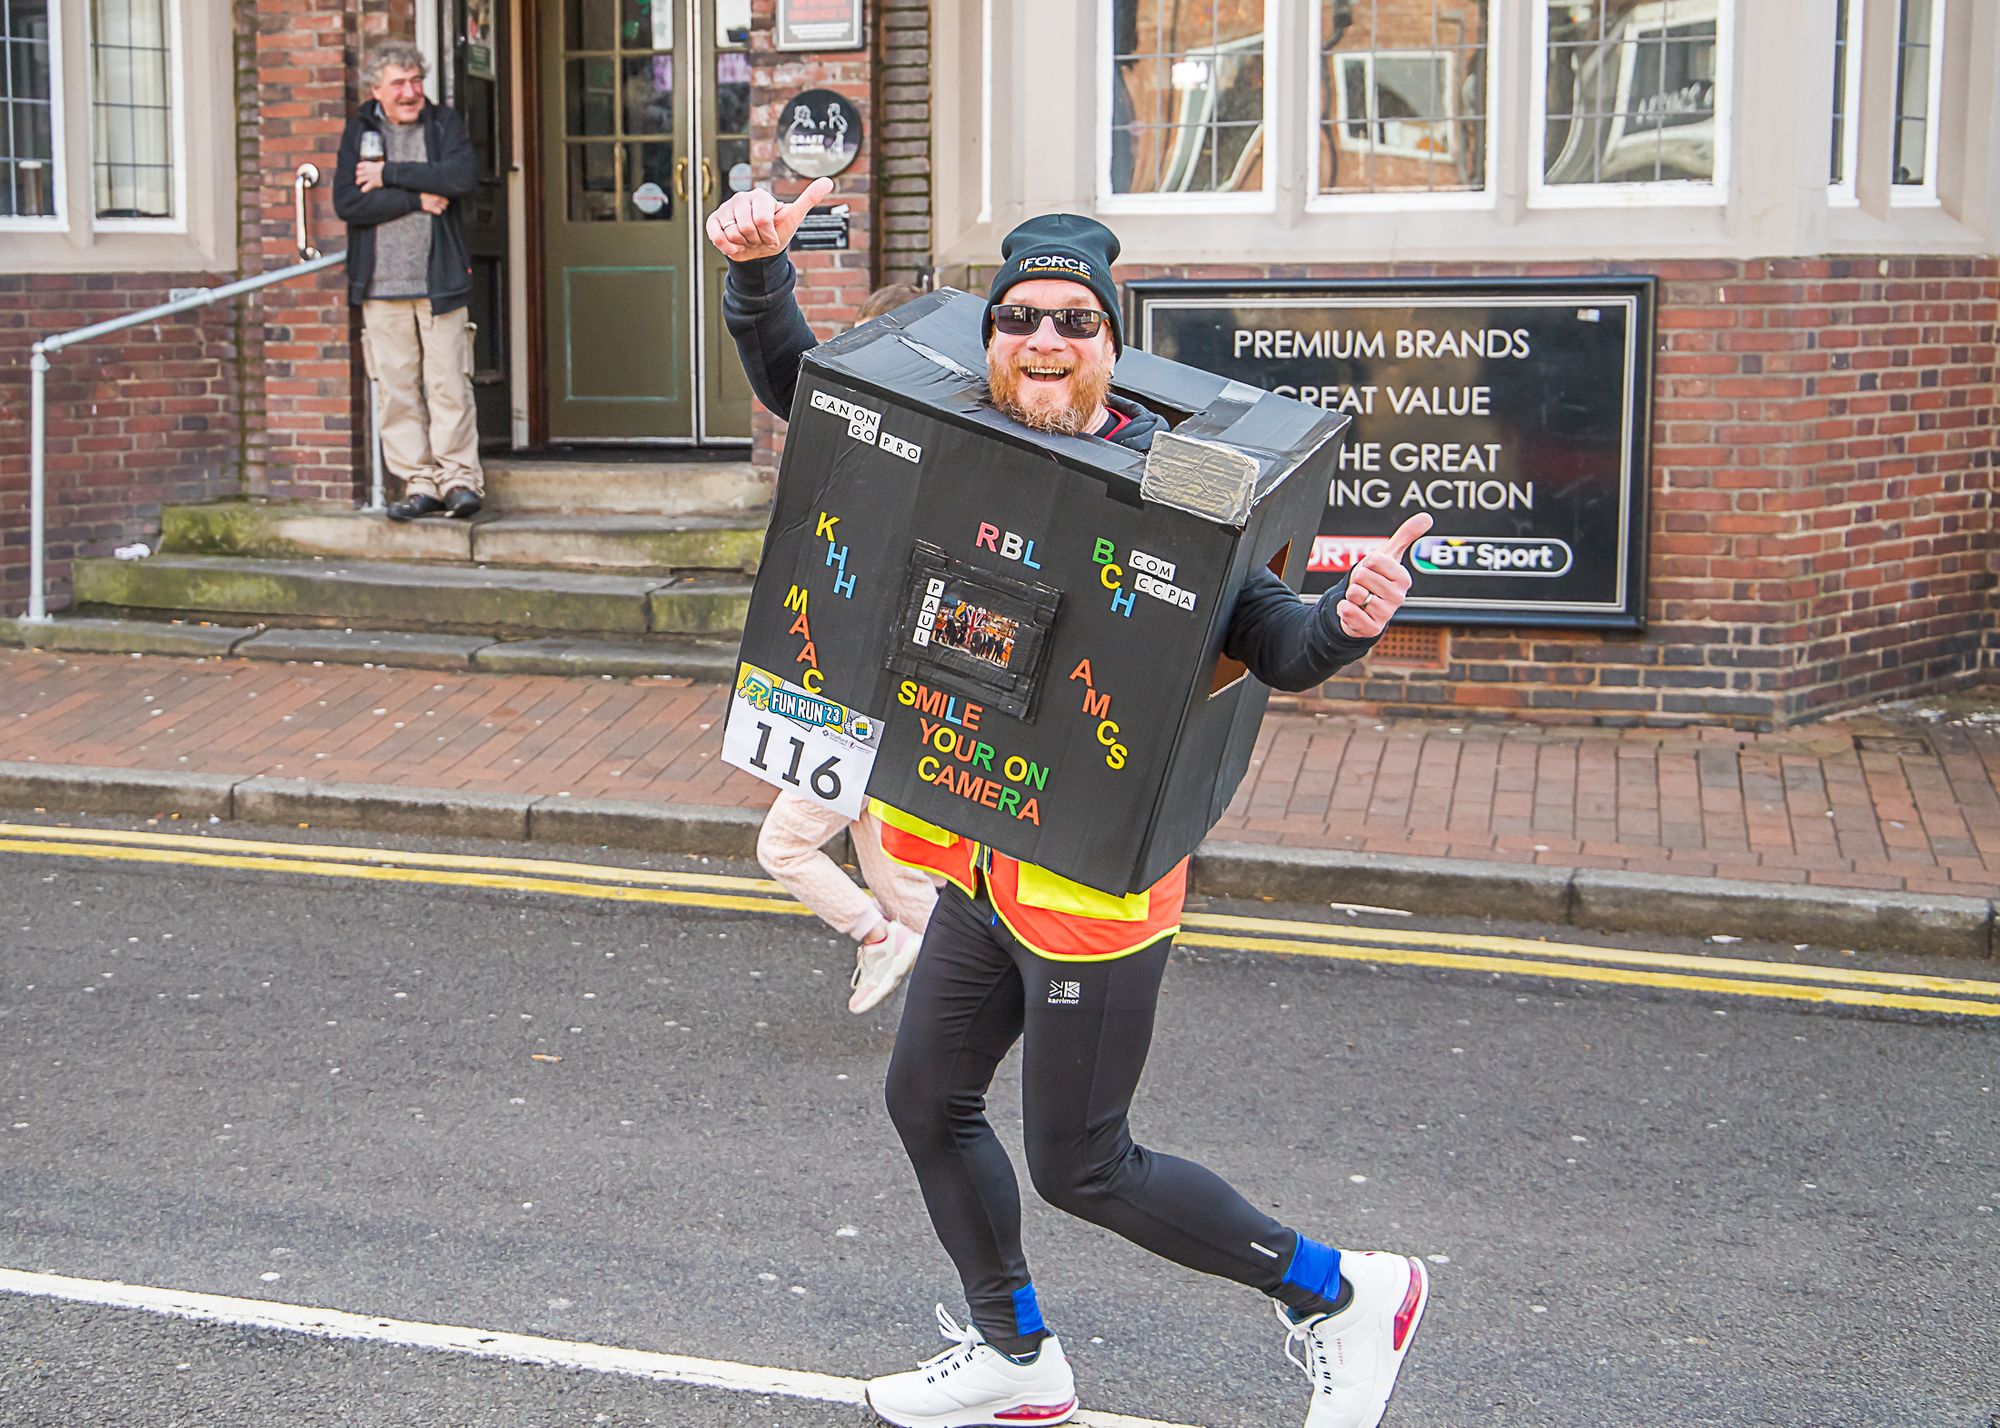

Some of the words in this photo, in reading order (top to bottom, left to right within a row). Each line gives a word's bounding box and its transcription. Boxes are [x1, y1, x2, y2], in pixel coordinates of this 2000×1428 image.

[1018, 255, 1091, 275] iFORCE
[1234, 329, 1385, 359] PREMIUM
[1395, 329, 1530, 359] BRANDS
[814, 394, 877, 426] CANON
[1386, 385, 1491, 416] VALUE
[851, 424, 875, 442] GO
[883, 436, 918, 459] PRO
[1338, 442, 1382, 472] HE
[1389, 442, 1502, 473] GREAT
[1328, 478, 1392, 509] ING
[1399, 480, 1534, 511] ACTION
[815, 511, 857, 599] KHH
[975, 521, 1041, 570] RBL
[1430, 545, 1474, 567] BT
[1476, 543, 1553, 570] Sport
[1092, 537, 1137, 618] BCH
[1133, 555, 1171, 578] COM
[1138, 578, 1191, 607] CCPA
[918, 582, 940, 643] PAUL
[783, 584, 824, 694] MAAC
[771, 693, 796, 717] FUN
[796, 697, 824, 724] RUN
[897, 680, 984, 731] SMILE
[1069, 658, 1128, 770] AMCS
[749, 721, 842, 801] 116
[920, 717, 996, 772] YOUR
[1004, 755, 1050, 791] ON
[917, 755, 1041, 826] CAMERA
